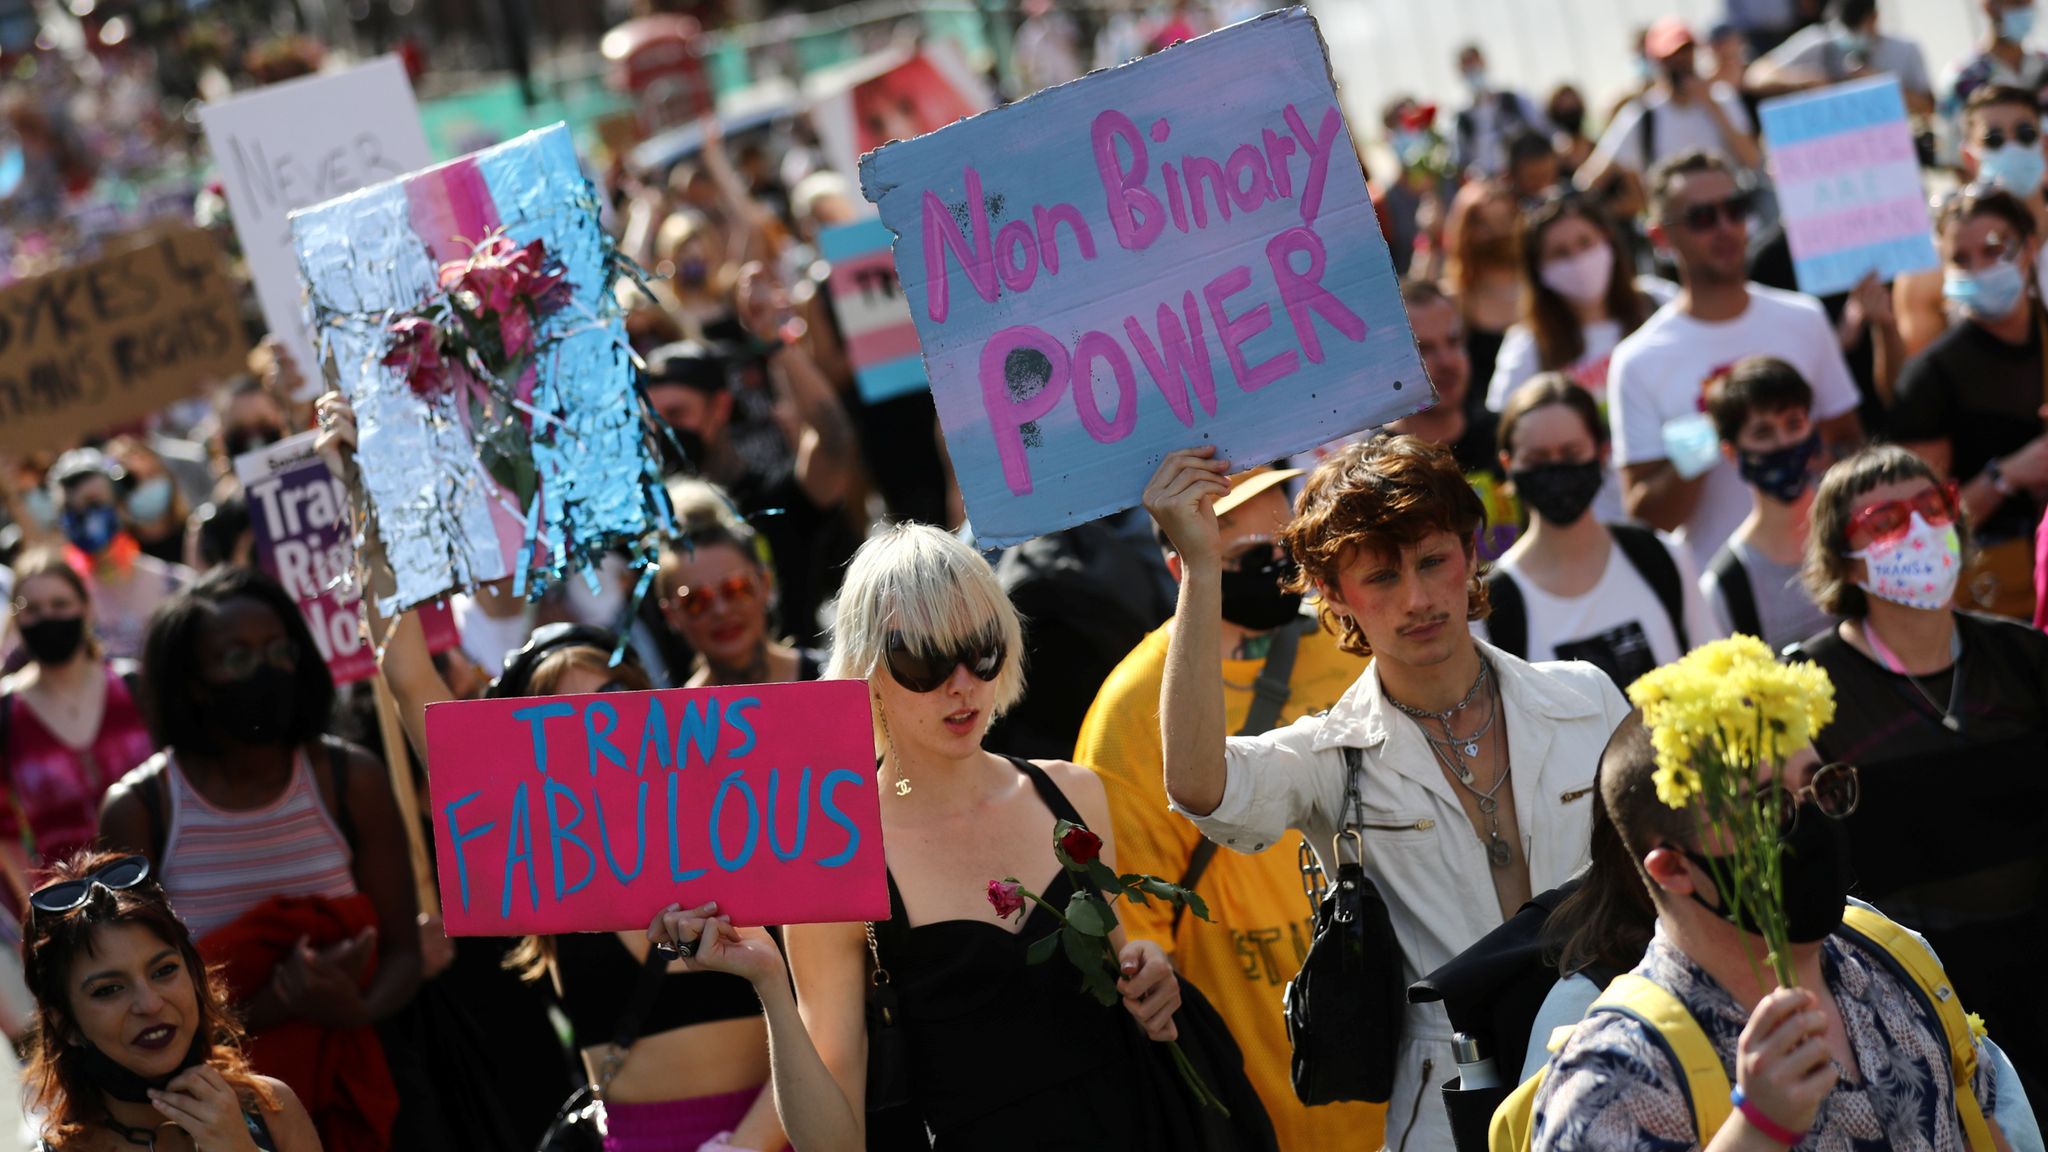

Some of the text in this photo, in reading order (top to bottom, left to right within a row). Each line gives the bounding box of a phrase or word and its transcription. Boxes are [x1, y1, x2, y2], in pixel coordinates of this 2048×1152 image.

[226, 132, 403, 222] NEVER
[921, 103, 1341, 323] Non Binary
[979, 227, 1369, 496] POWER
[512, 696, 761, 776] TRANS
[445, 767, 863, 918] FABULOUS
